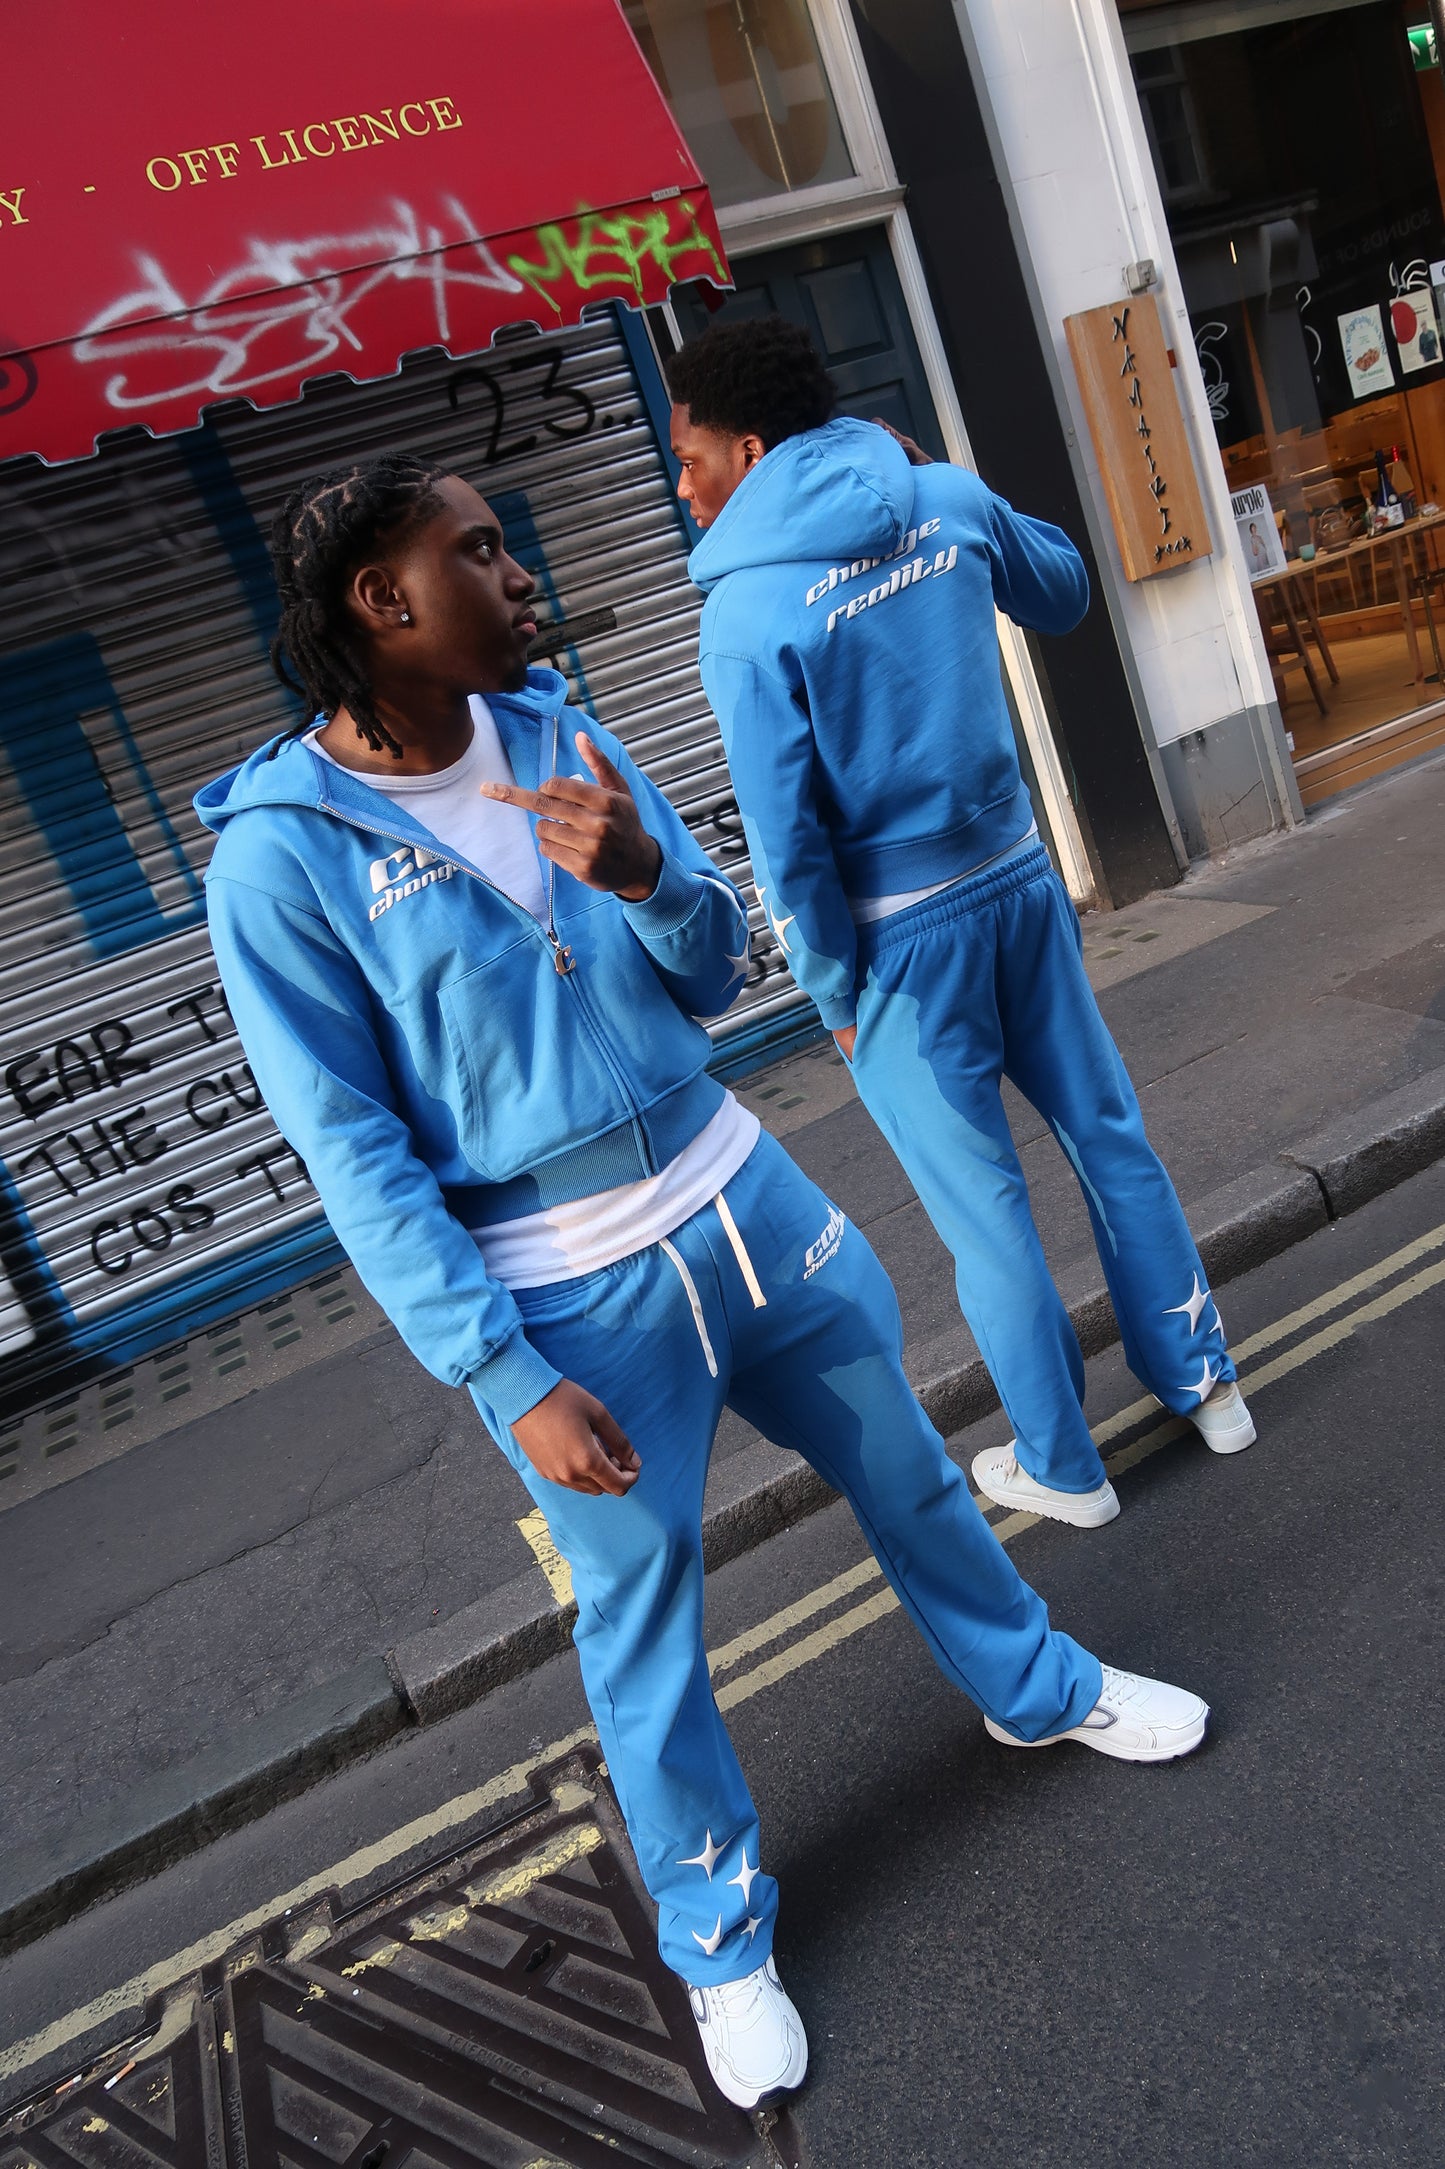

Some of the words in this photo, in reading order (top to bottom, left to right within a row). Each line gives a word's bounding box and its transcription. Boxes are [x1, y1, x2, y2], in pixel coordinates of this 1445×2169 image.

[144, 141, 242, 193] OFF
[250, 95, 464, 171] LICENCE
[1231, 488, 1265, 516] urple
[827, 545, 958, 633] reality
[5, 1020, 151, 1122] EAR
[17, 1106, 168, 1197] THE
[90, 1183, 215, 1275] COS
